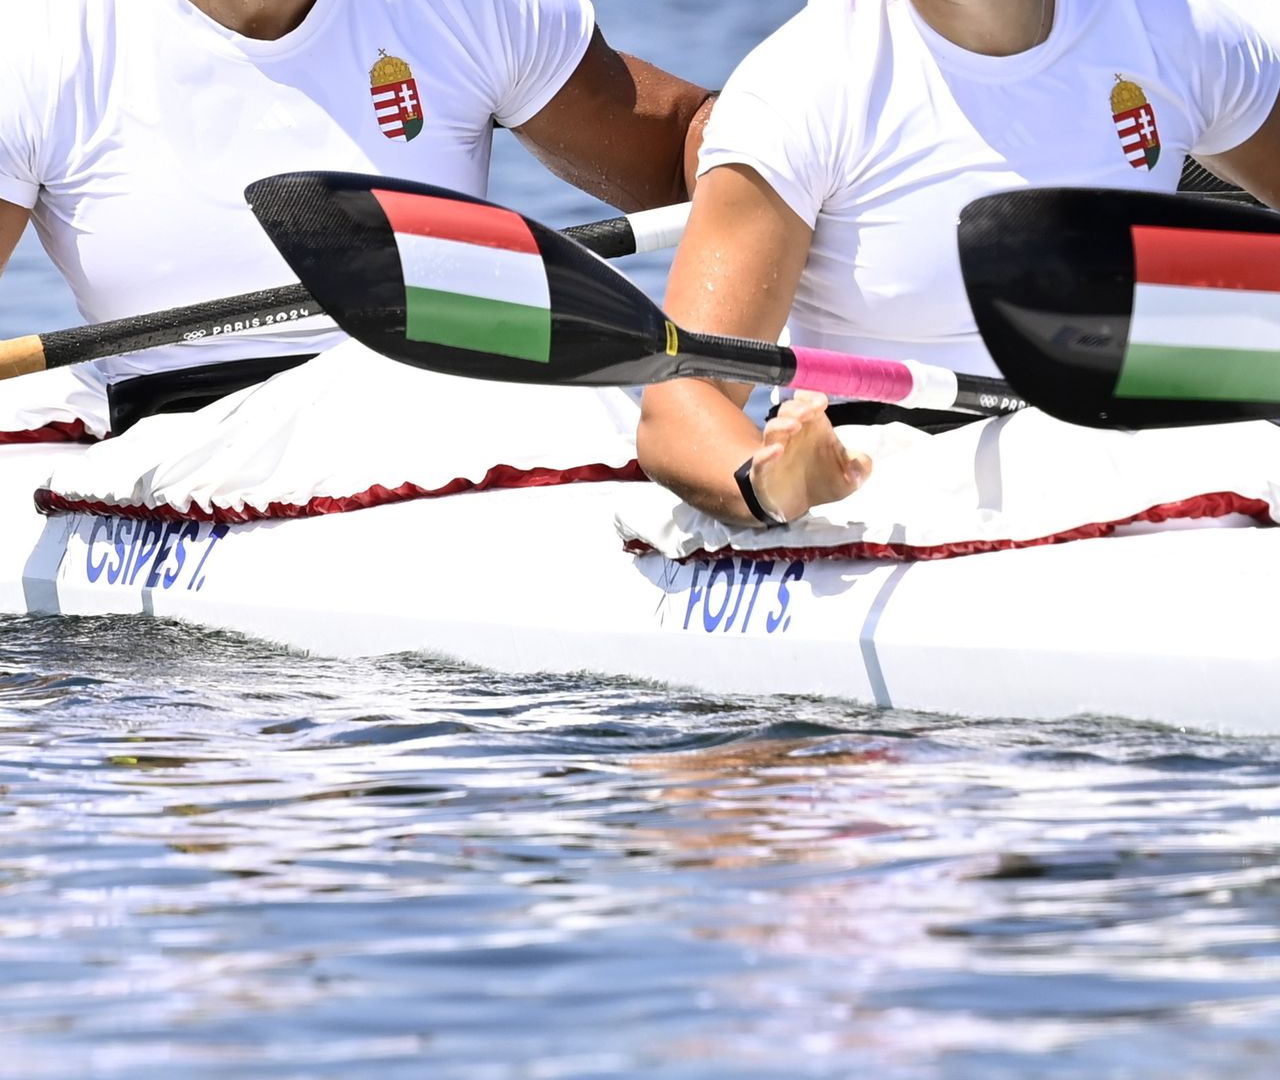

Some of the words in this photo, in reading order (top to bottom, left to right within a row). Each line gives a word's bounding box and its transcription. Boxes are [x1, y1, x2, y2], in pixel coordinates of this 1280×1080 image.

[213, 318, 260, 336] PARIS
[265, 308, 309, 325] 2024
[86, 515, 200, 590] CSIPES
[186, 524, 231, 592] T.
[683, 558, 775, 633] FOJT
[766, 559, 805, 634] S.
